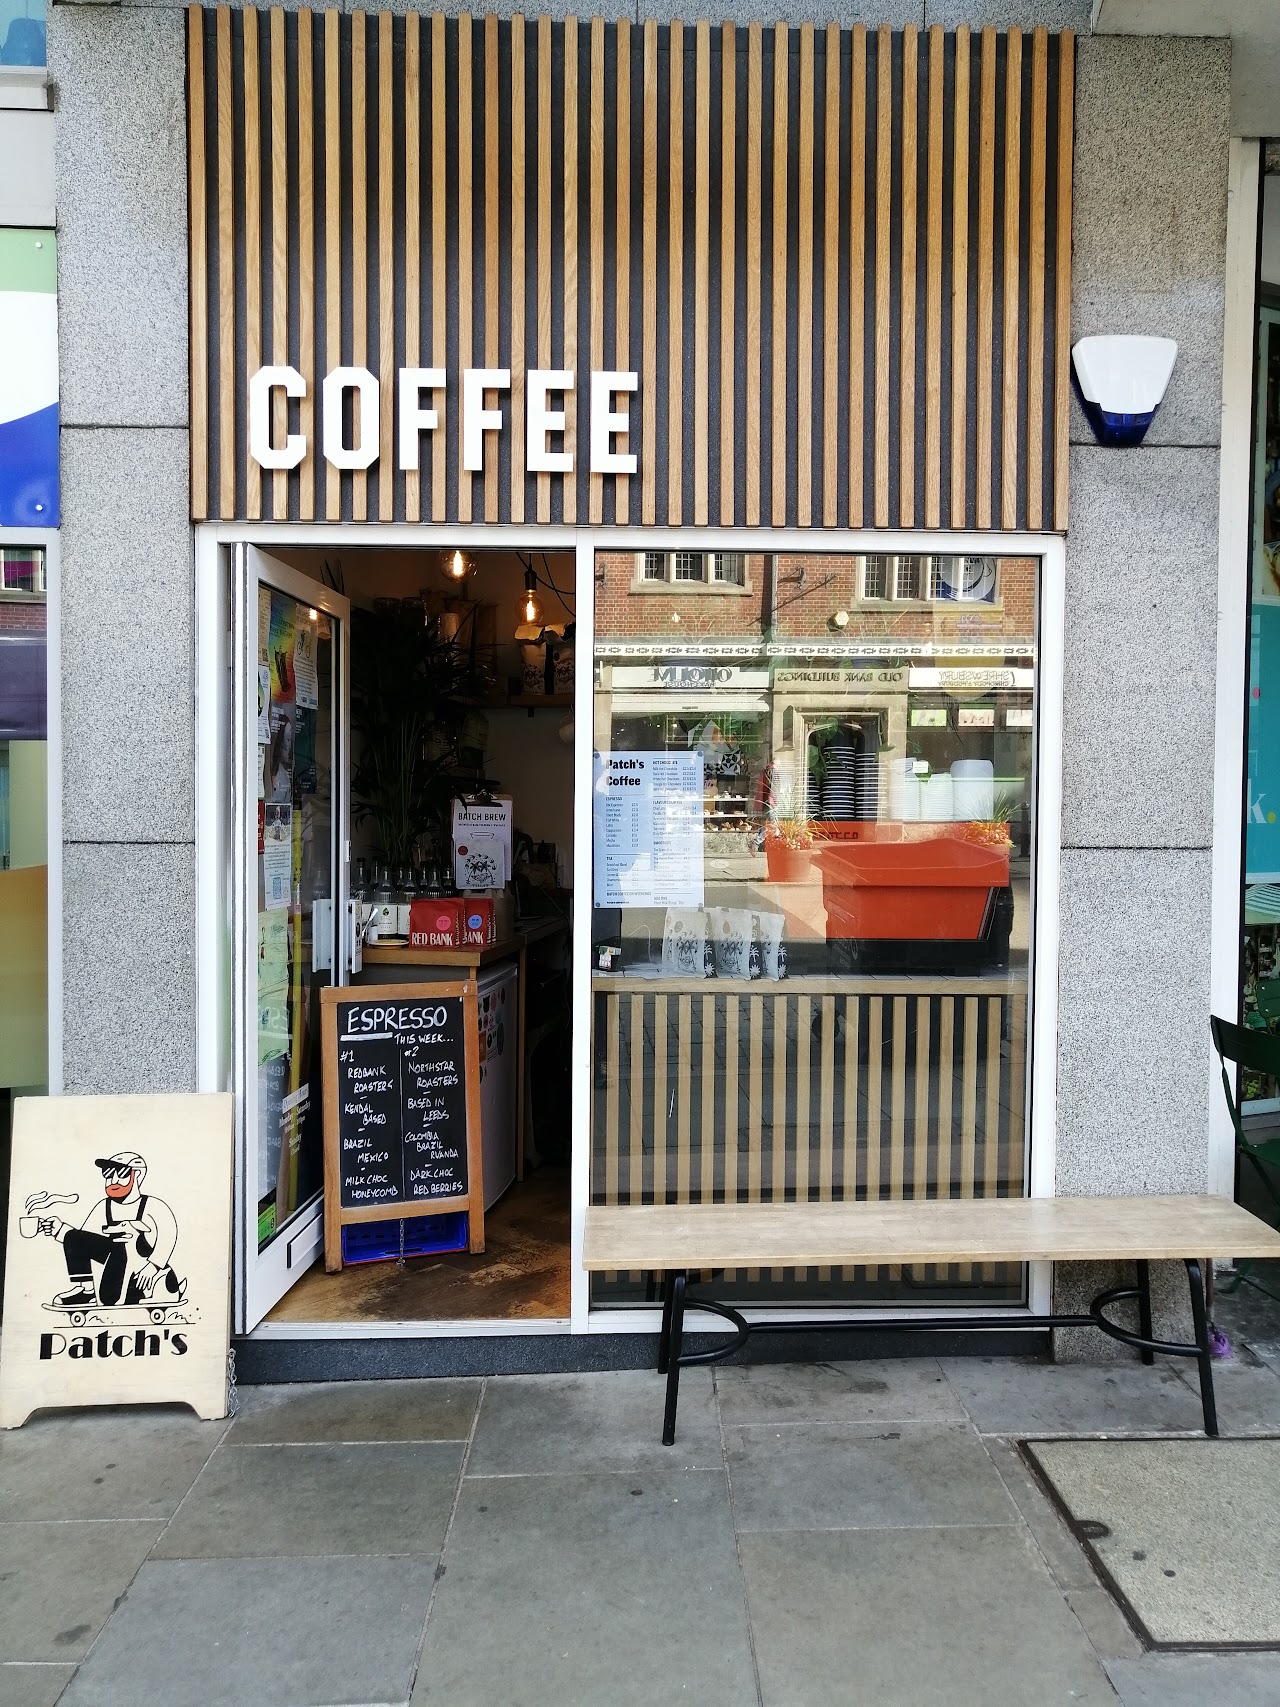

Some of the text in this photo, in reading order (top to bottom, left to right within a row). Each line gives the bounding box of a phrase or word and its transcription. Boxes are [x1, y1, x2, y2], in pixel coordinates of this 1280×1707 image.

[250, 365, 638, 474] COFFEE
[606, 760, 644, 769] Patch's
[606, 776, 641, 786] Coffee
[458, 813, 506, 821] BATCH BREW
[412, 932, 453, 946] RED BANK
[347, 1006, 448, 1033] ESPRESSO
[394, 1033, 415, 1044] THIS
[340, 1051, 355, 1063] #1
[347, 1066, 387, 1079] REDBANK
[408, 1061, 455, 1074] NORTHSTAR
[354, 1081, 393, 1094] ROASTERS
[416, 1076, 459, 1089] ROASTERS
[345, 1102, 374, 1114] KENDAL
[407, 1097, 445, 1109] BASED IN
[363, 1114, 387, 1125] BASED
[423, 1109, 450, 1121] LEEDS
[405, 1131, 440, 1143] COLOMBIA
[344, 1139, 373, 1151] BRAZIL
[416, 1141, 444, 1152] BRAZIL
[358, 1152, 389, 1163] MEXICO
[345, 1174, 388, 1187] MILK CHOC
[410, 1168, 454, 1181] DARK CHOC
[351, 1186, 398, 1199] HONEYCOMB
[413, 1181, 463, 1196] RED BERRIES
[39, 1329, 188, 1360] Patch's
